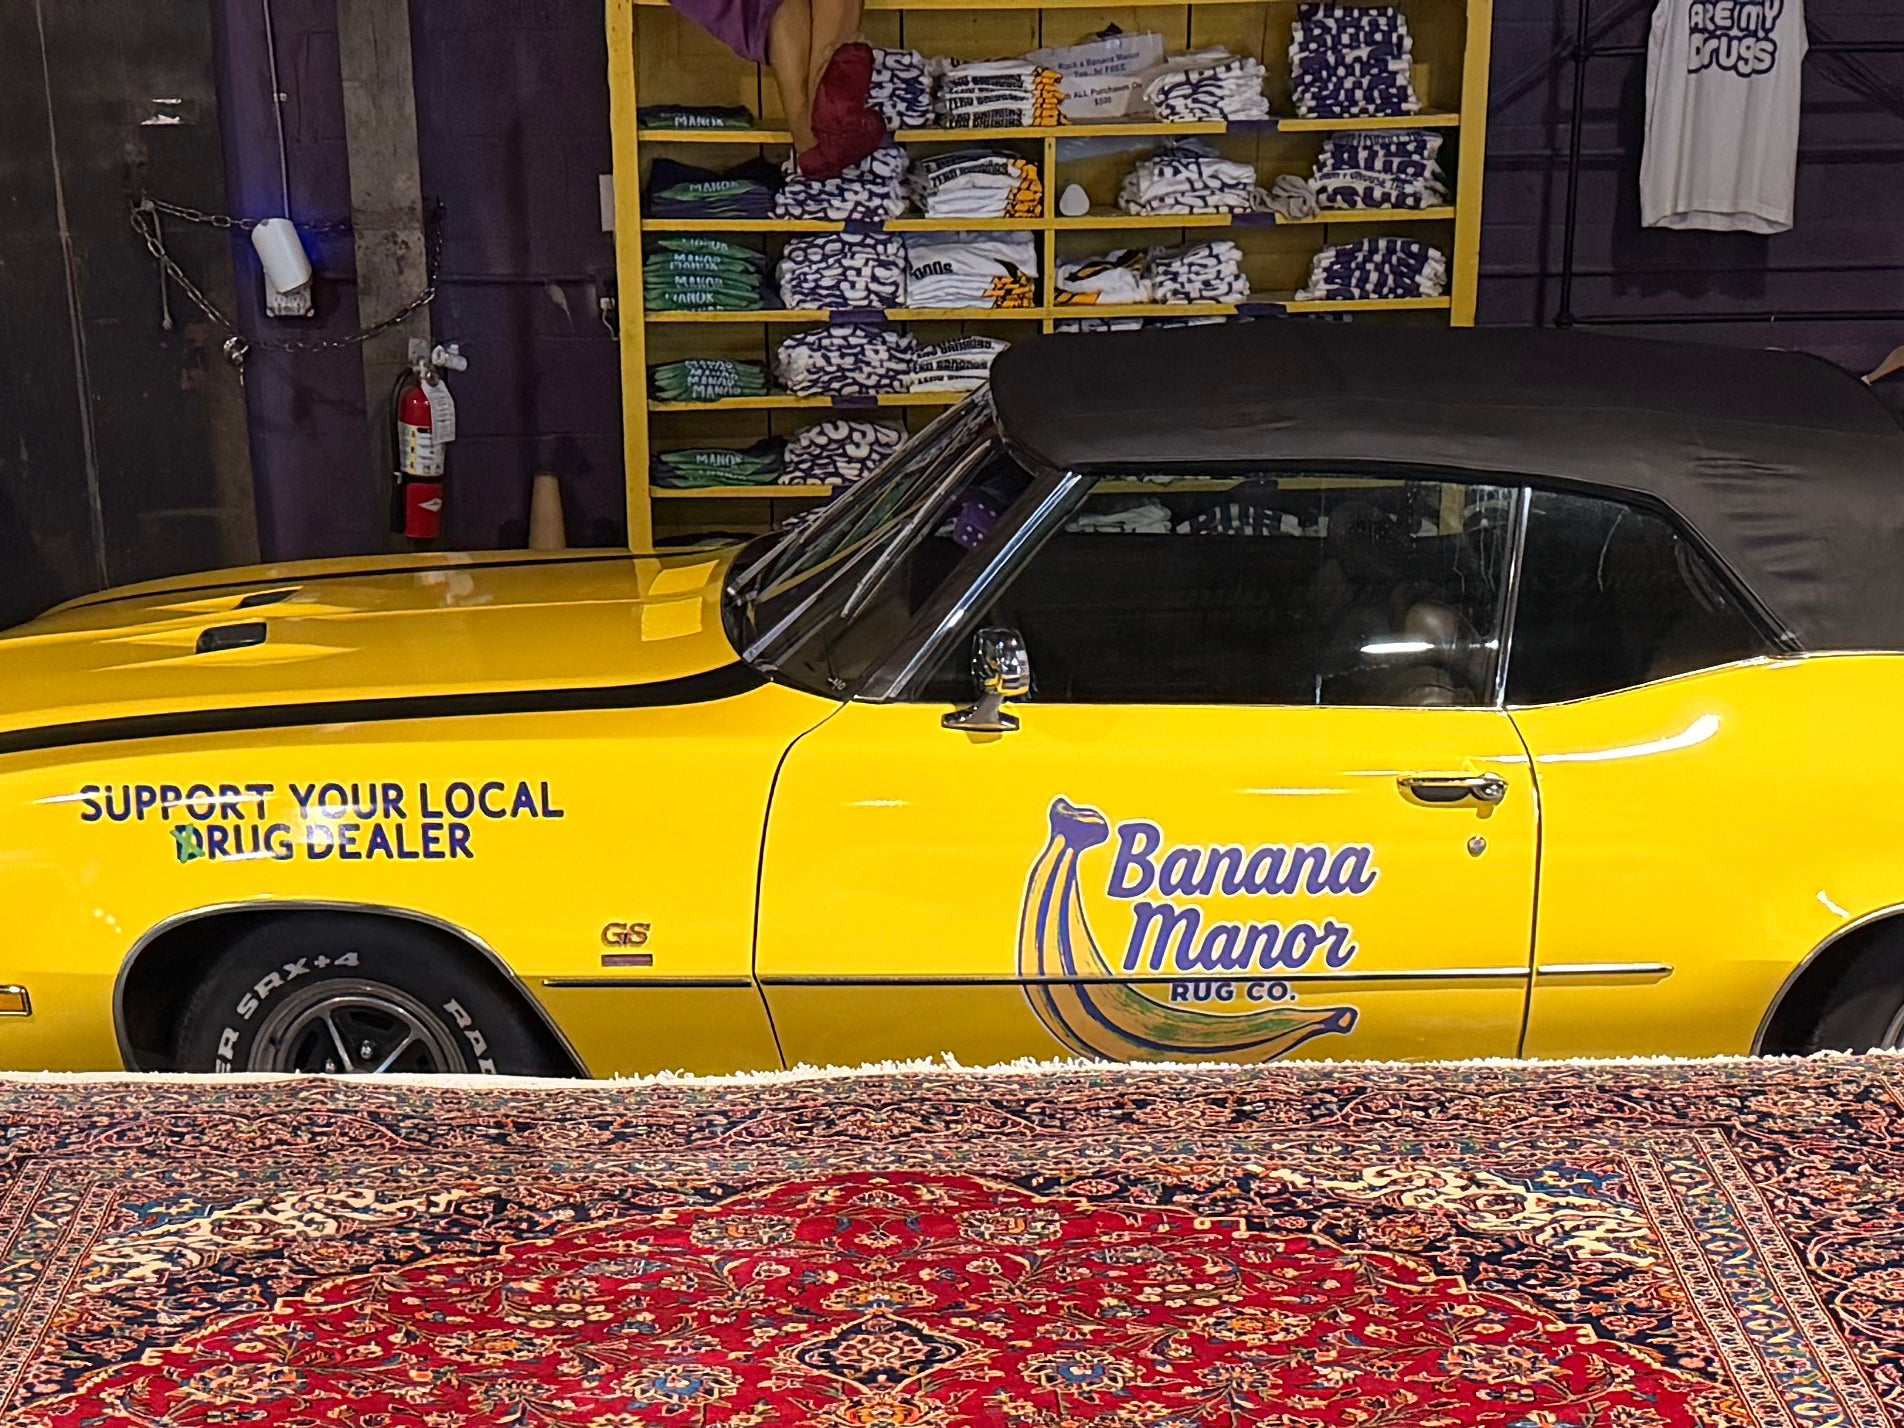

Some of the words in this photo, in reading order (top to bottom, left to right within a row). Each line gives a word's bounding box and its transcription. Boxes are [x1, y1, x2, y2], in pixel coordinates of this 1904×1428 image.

[80, 783, 275, 822] SUPPORT
[288, 781, 406, 820] YOUR
[419, 780, 565, 820] LOCAL
[306, 821, 475, 860] DEALER
[1107, 822, 1378, 899] Banana
[600, 922, 652, 949] GS
[1122, 901, 1360, 972] Manor
[1170, 982, 1234, 1002] RUG
[1246, 981, 1297, 1002] CO.
